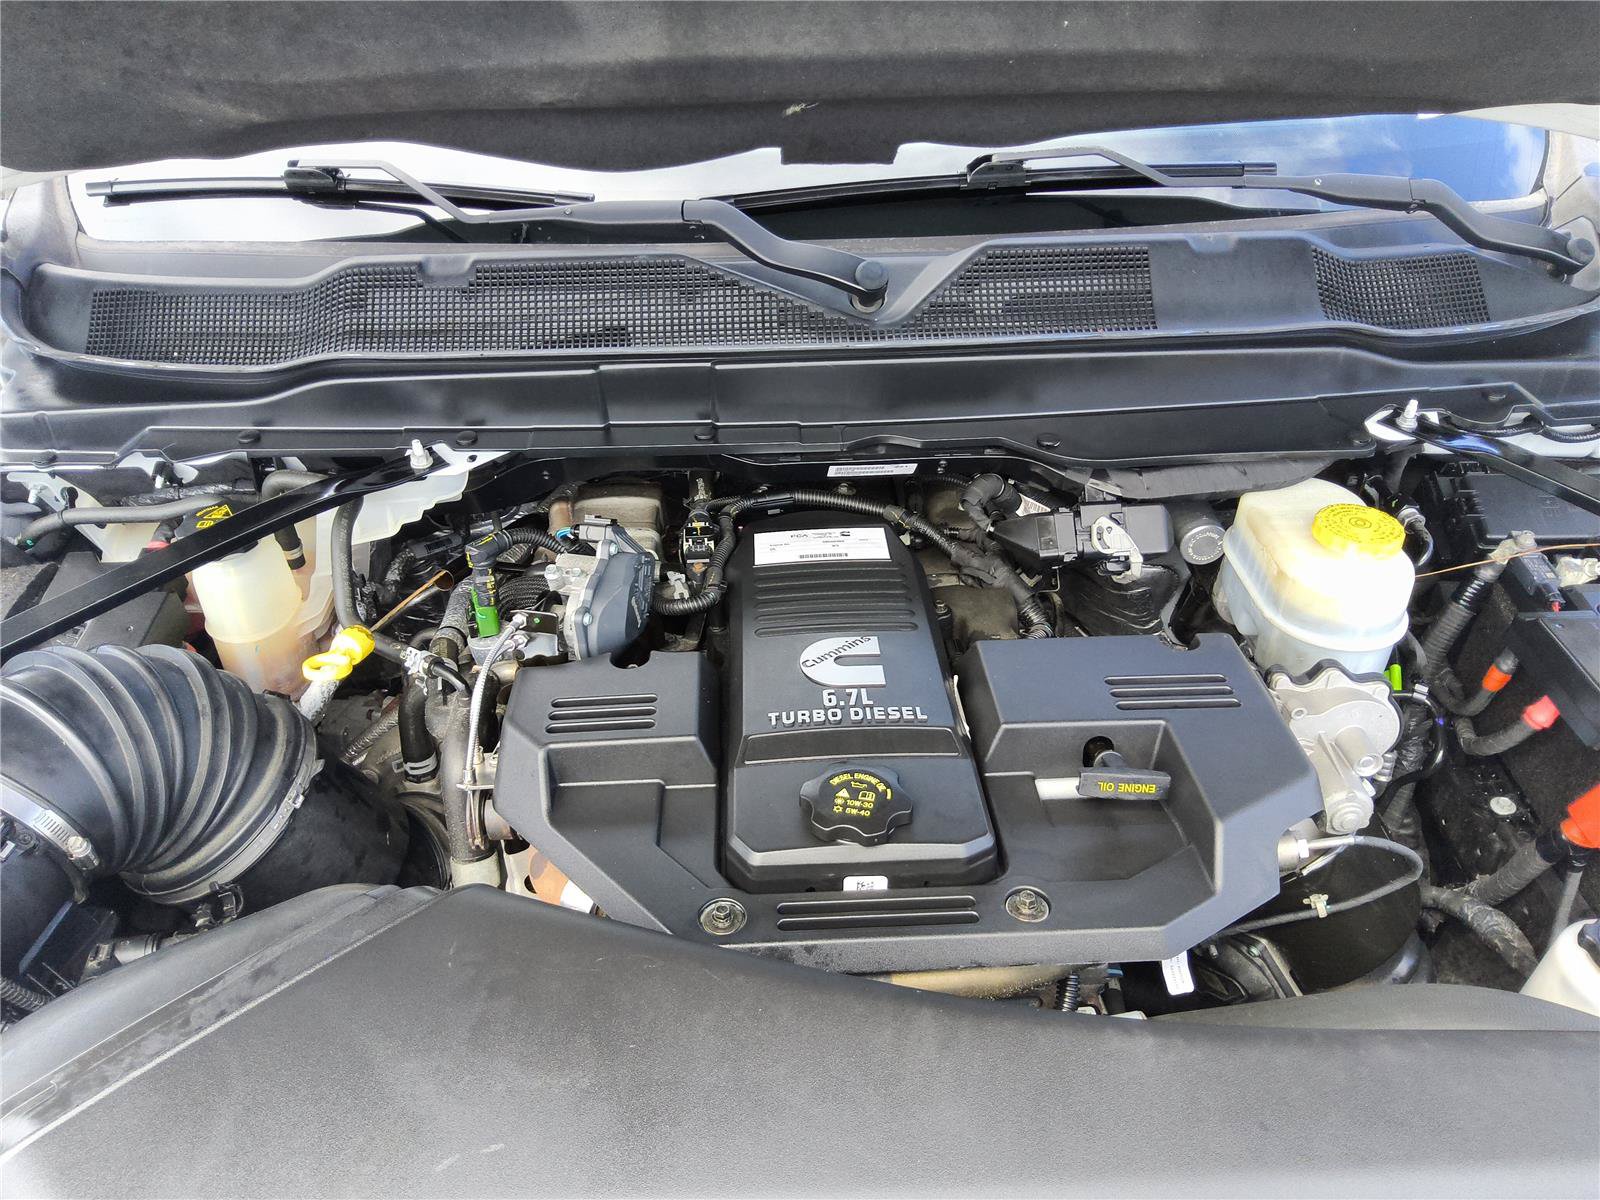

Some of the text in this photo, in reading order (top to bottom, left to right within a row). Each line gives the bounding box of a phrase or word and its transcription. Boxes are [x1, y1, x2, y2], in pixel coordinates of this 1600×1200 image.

[801, 635, 872, 668] Cummins
[822, 688, 874, 706] 6.7L
[767, 706, 928, 726] TURBO DIESEL
[830, 773, 853, 785] DIESEL
[854, 772, 881, 786] ENGINE
[1098, 782, 1156, 793] ENGINE OIL
[847, 800, 873, 809] 10W-30
